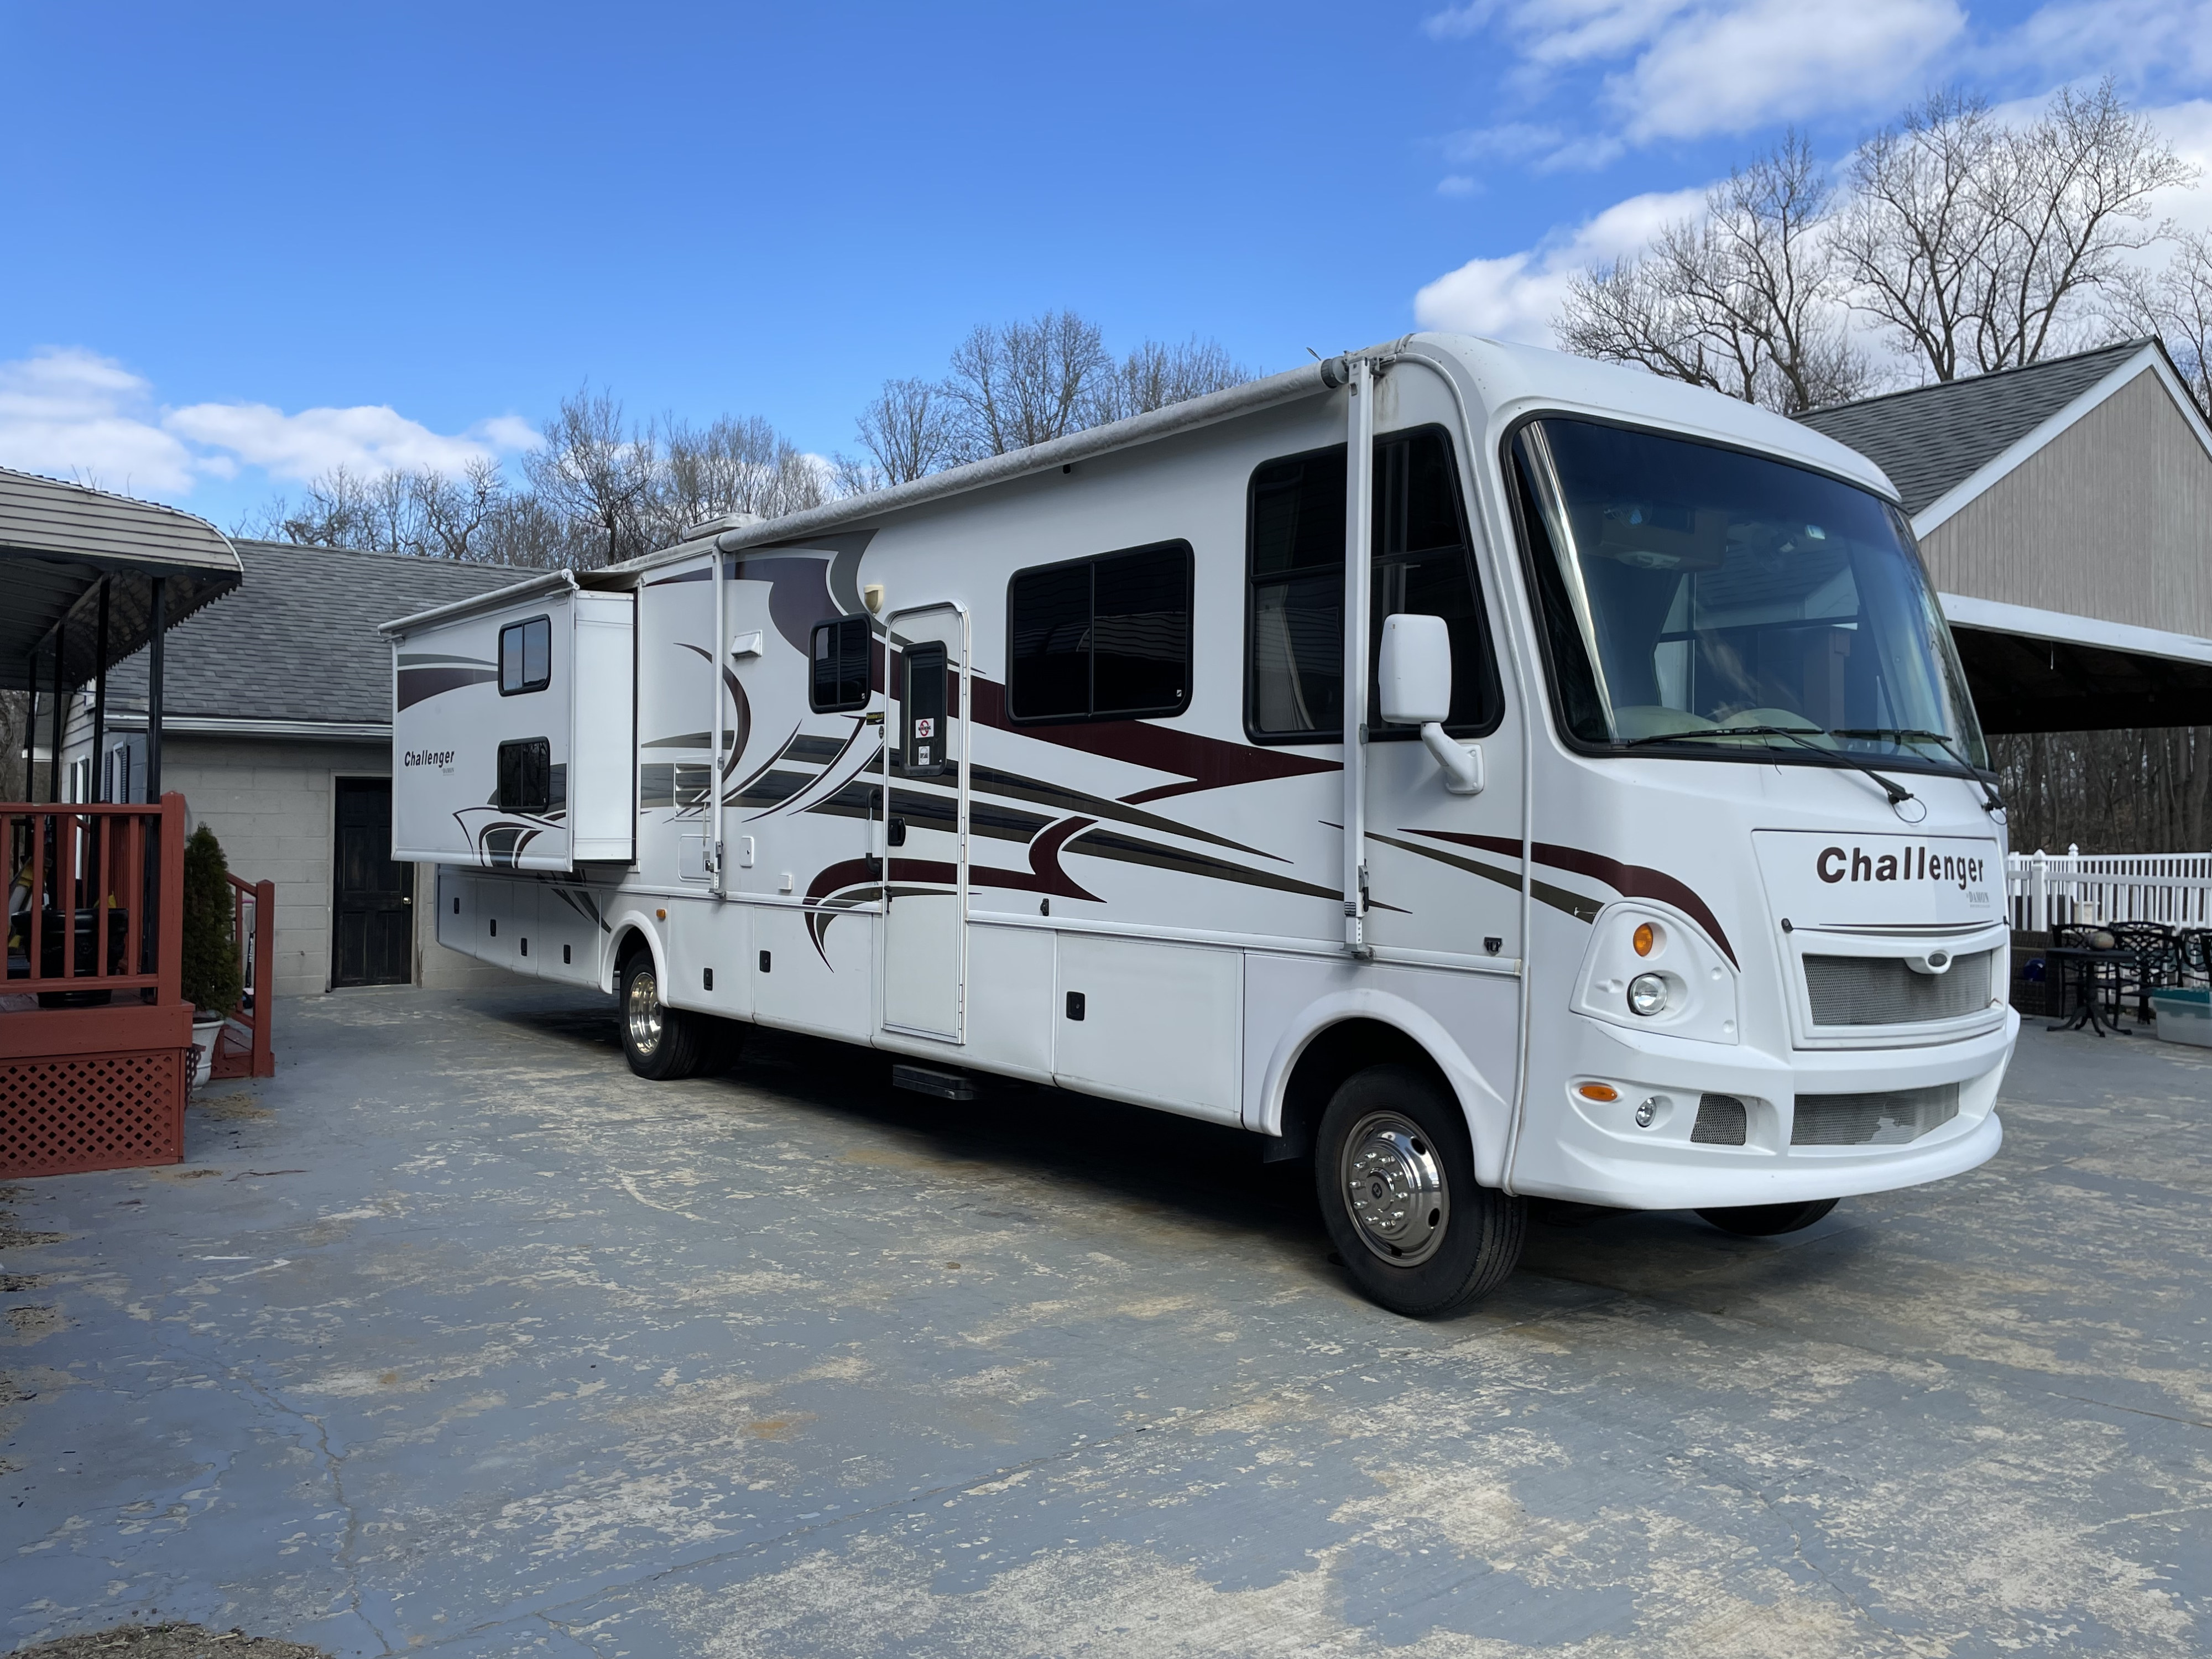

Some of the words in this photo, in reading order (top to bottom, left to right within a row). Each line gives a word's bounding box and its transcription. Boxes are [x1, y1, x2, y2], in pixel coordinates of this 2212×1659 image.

[404, 750, 455, 768] Challenger
[1817, 847, 1983, 890] Challenger
[1969, 891, 1989, 903] DAMON
